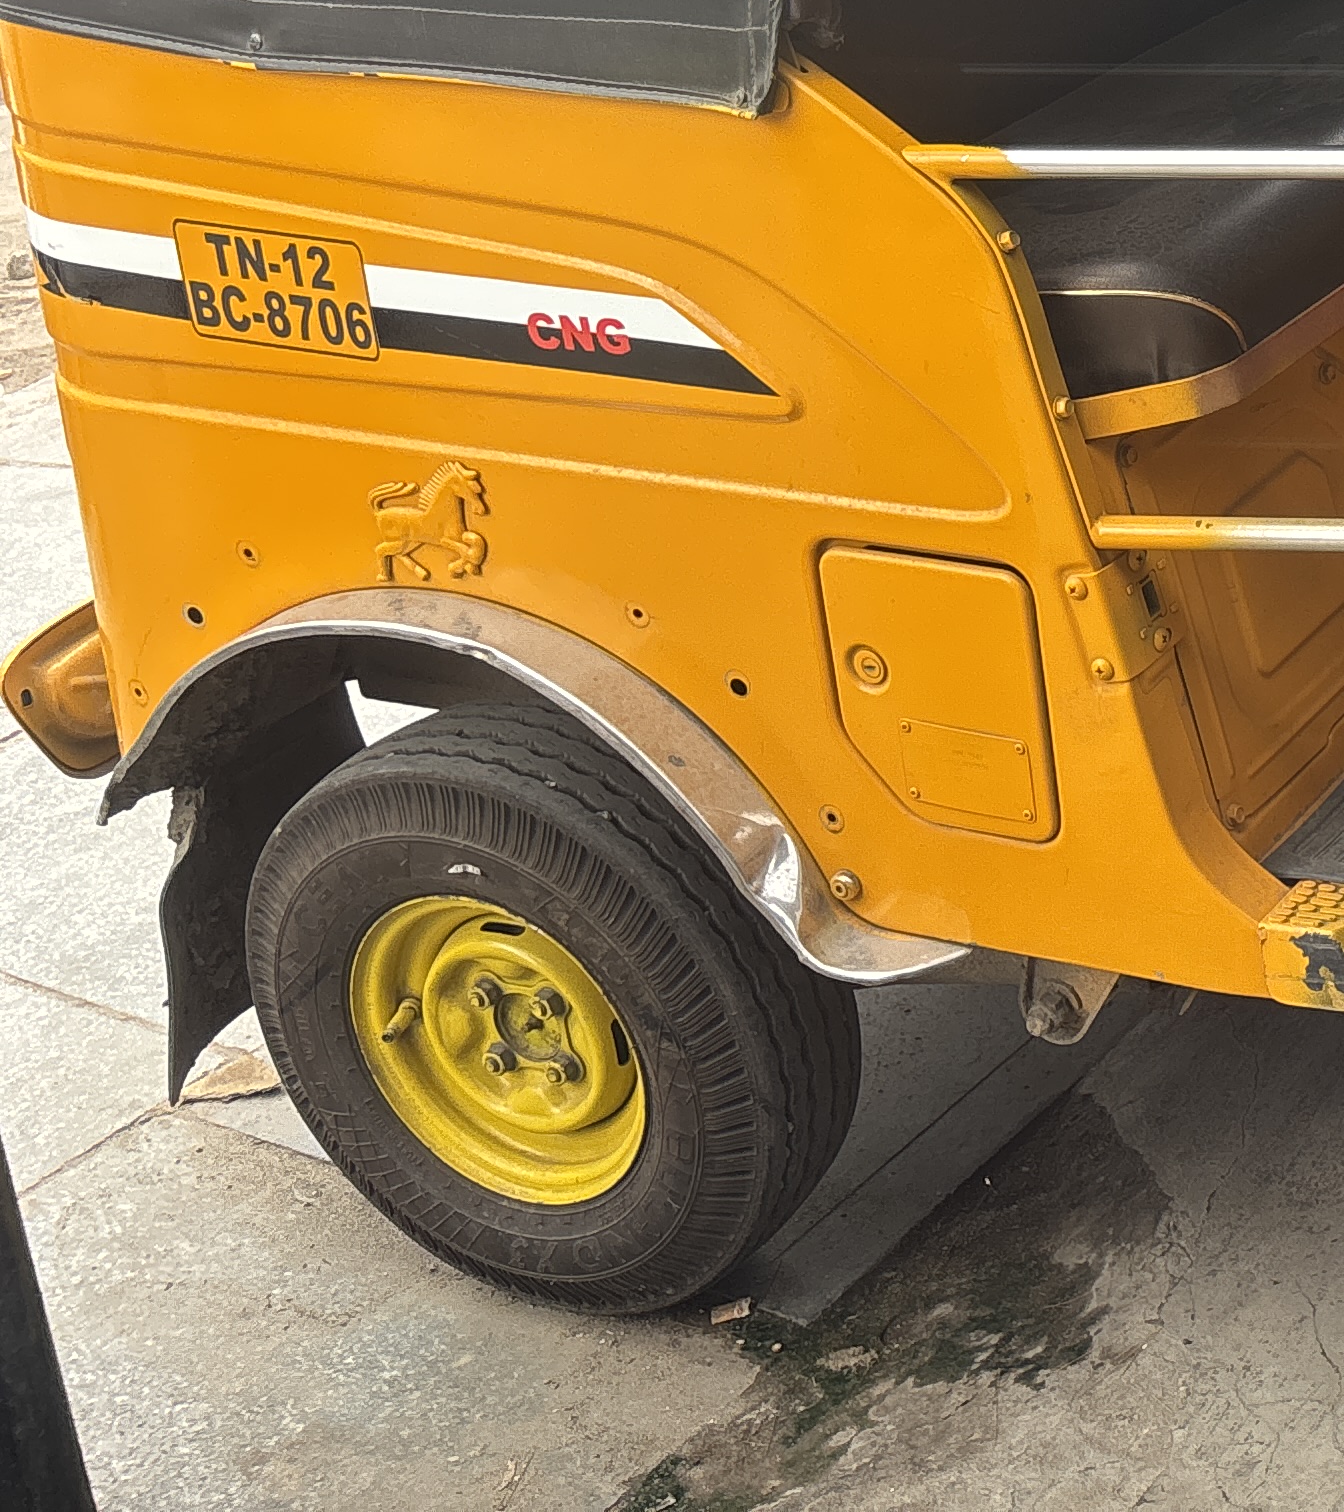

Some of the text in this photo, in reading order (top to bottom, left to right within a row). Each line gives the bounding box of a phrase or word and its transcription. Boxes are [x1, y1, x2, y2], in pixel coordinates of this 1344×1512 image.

[203, 232, 335, 291] TN-12
[190, 280, 373, 350] BC-8706
[526, 312, 632, 355] CNG
